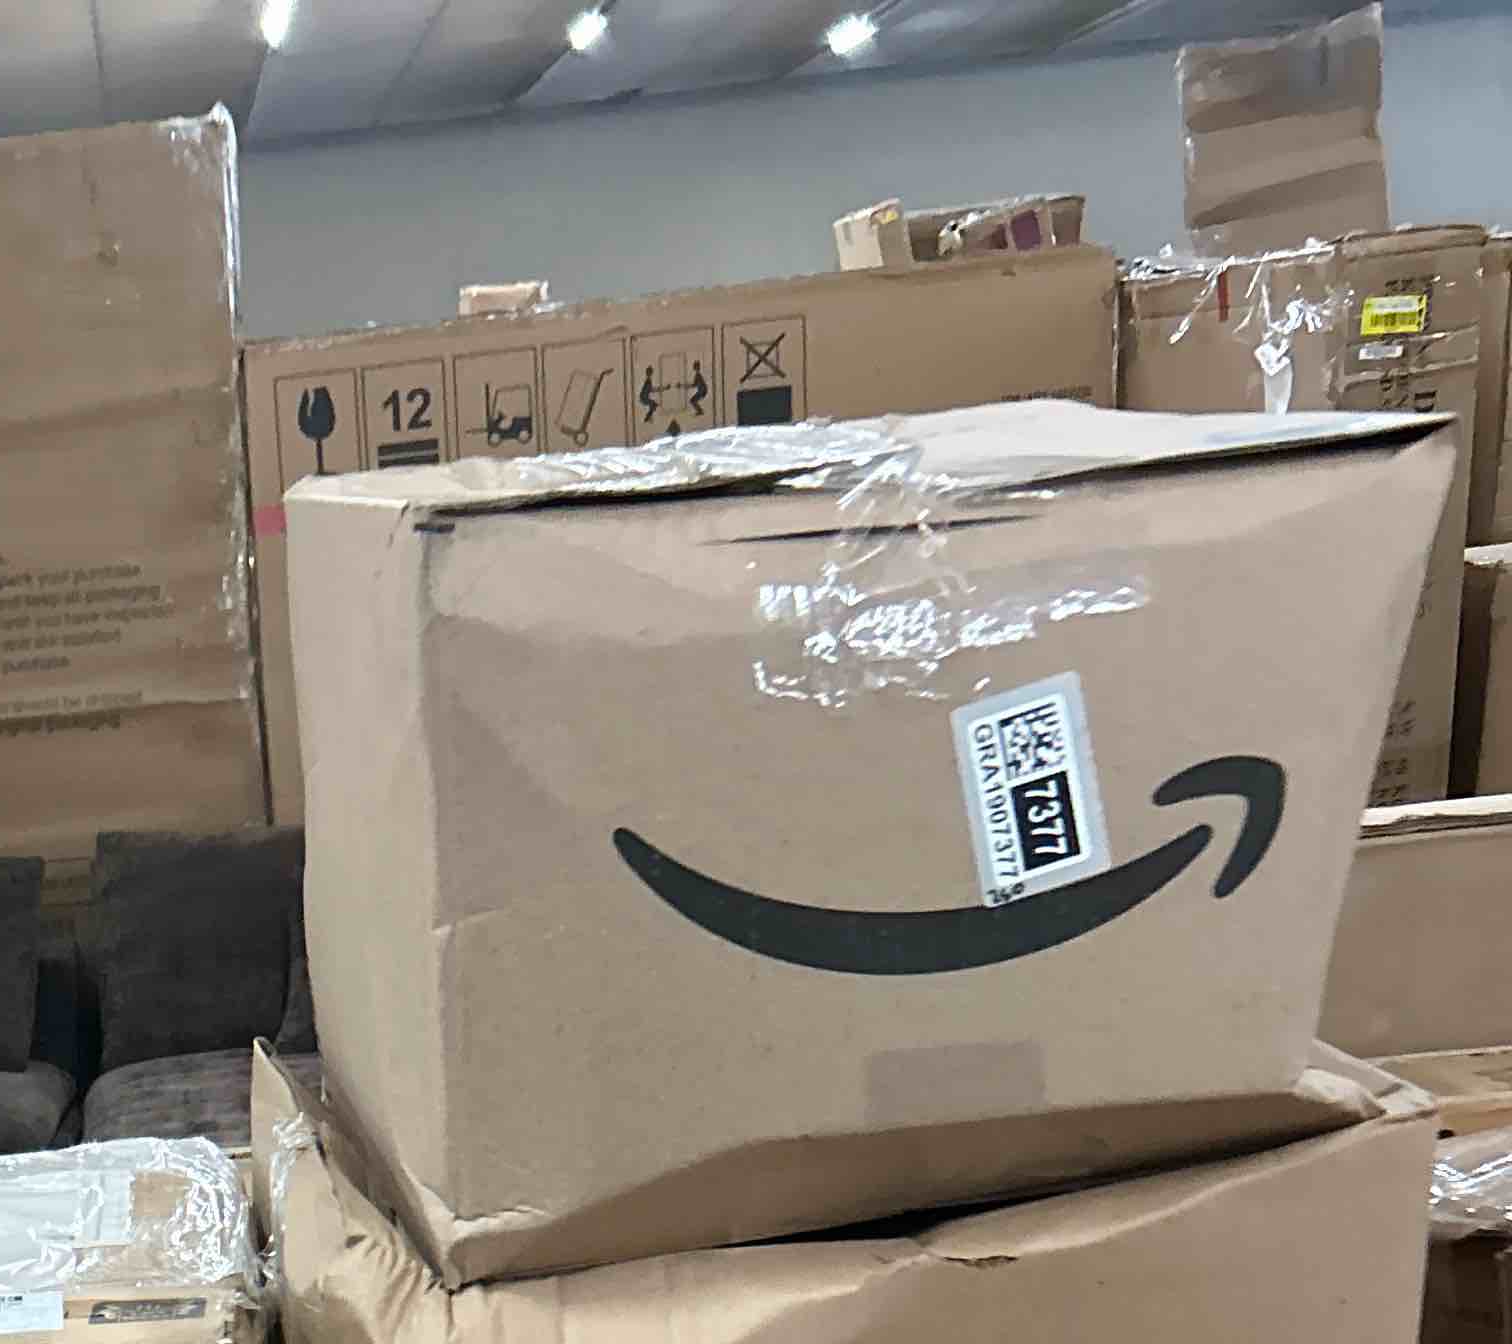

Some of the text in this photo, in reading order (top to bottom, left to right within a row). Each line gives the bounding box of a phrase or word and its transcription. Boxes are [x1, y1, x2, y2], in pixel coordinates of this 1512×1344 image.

[382, 387, 432, 432] 12
[974, 722, 1019, 878] GRA1907377
[1022, 780, 1068, 855] 7377
